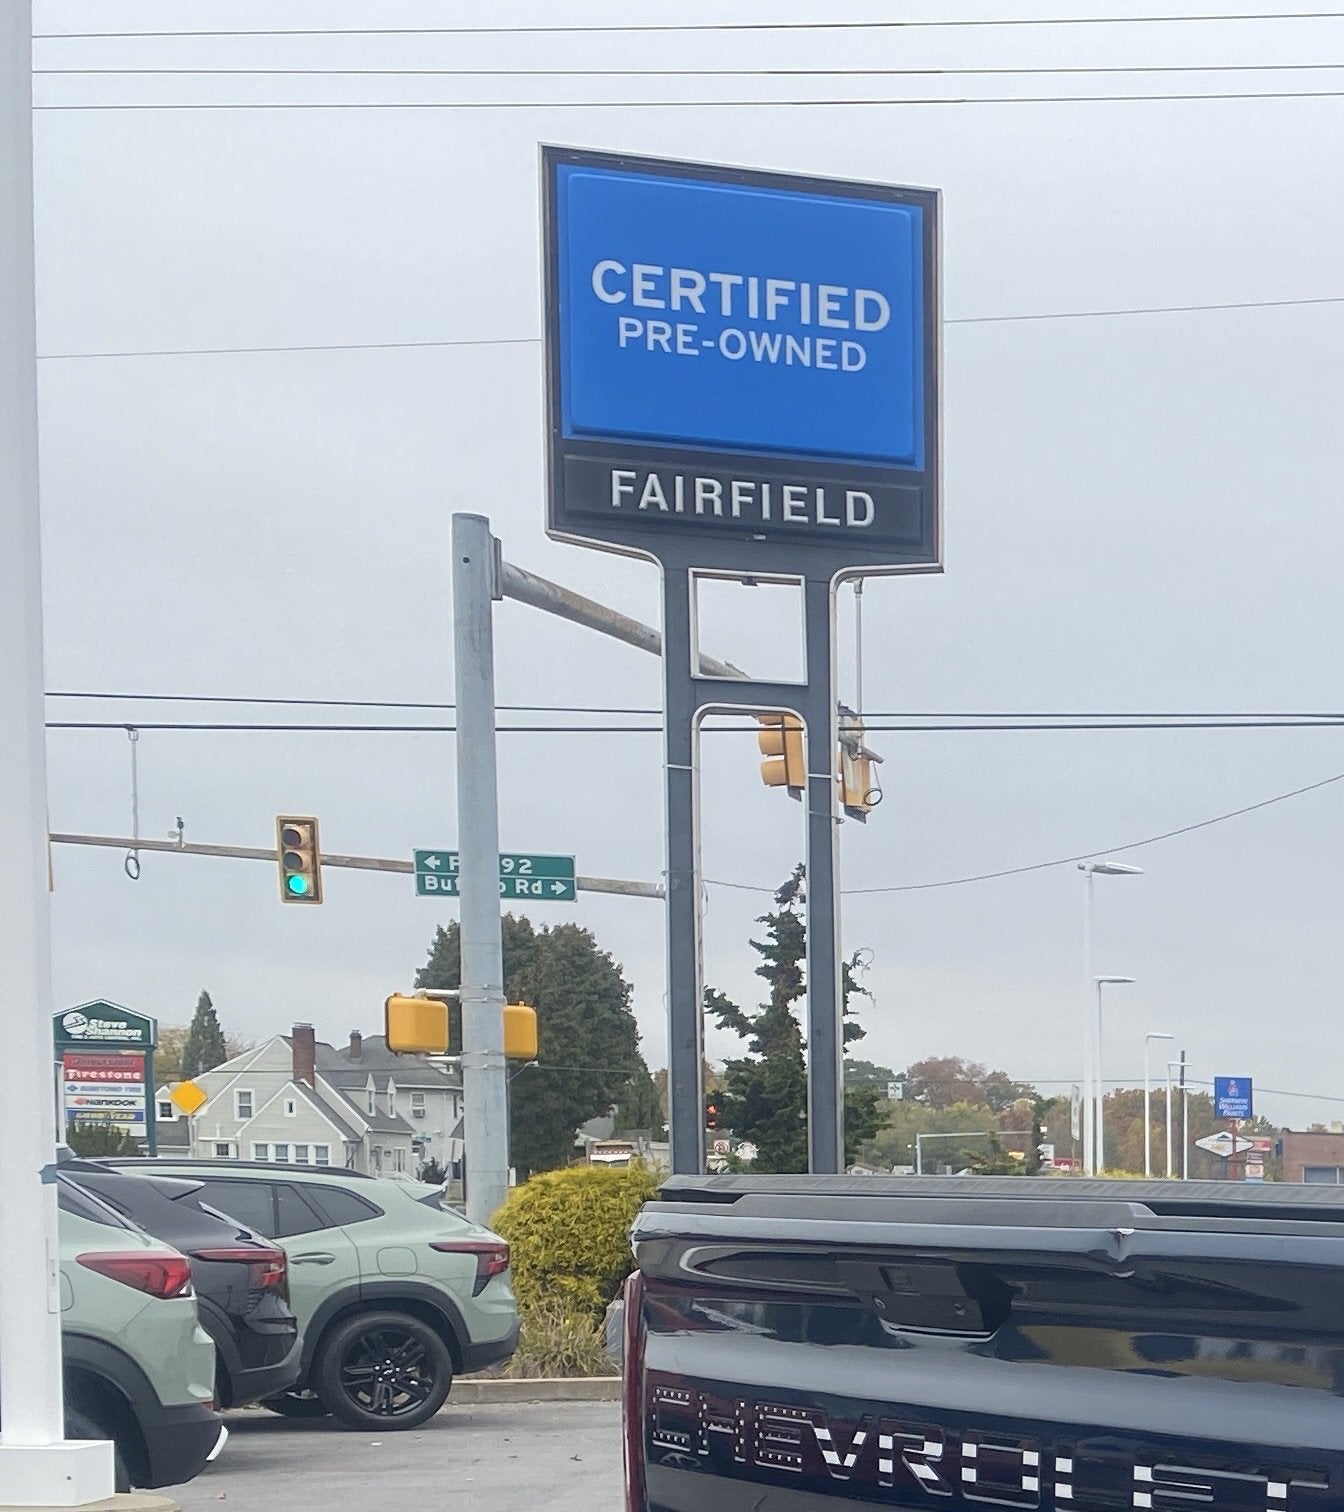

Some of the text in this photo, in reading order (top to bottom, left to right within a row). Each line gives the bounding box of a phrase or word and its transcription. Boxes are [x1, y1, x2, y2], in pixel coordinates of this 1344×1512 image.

[592, 260, 891, 332] CERTIFIED
[618, 316, 867, 372] PRE-OWNED
[611, 469, 875, 528] FAIRFIELD
[515, 879, 543, 895] Rd
[89, 1018, 127, 1029] Steve
[66, 1069, 141, 1080] Firestone
